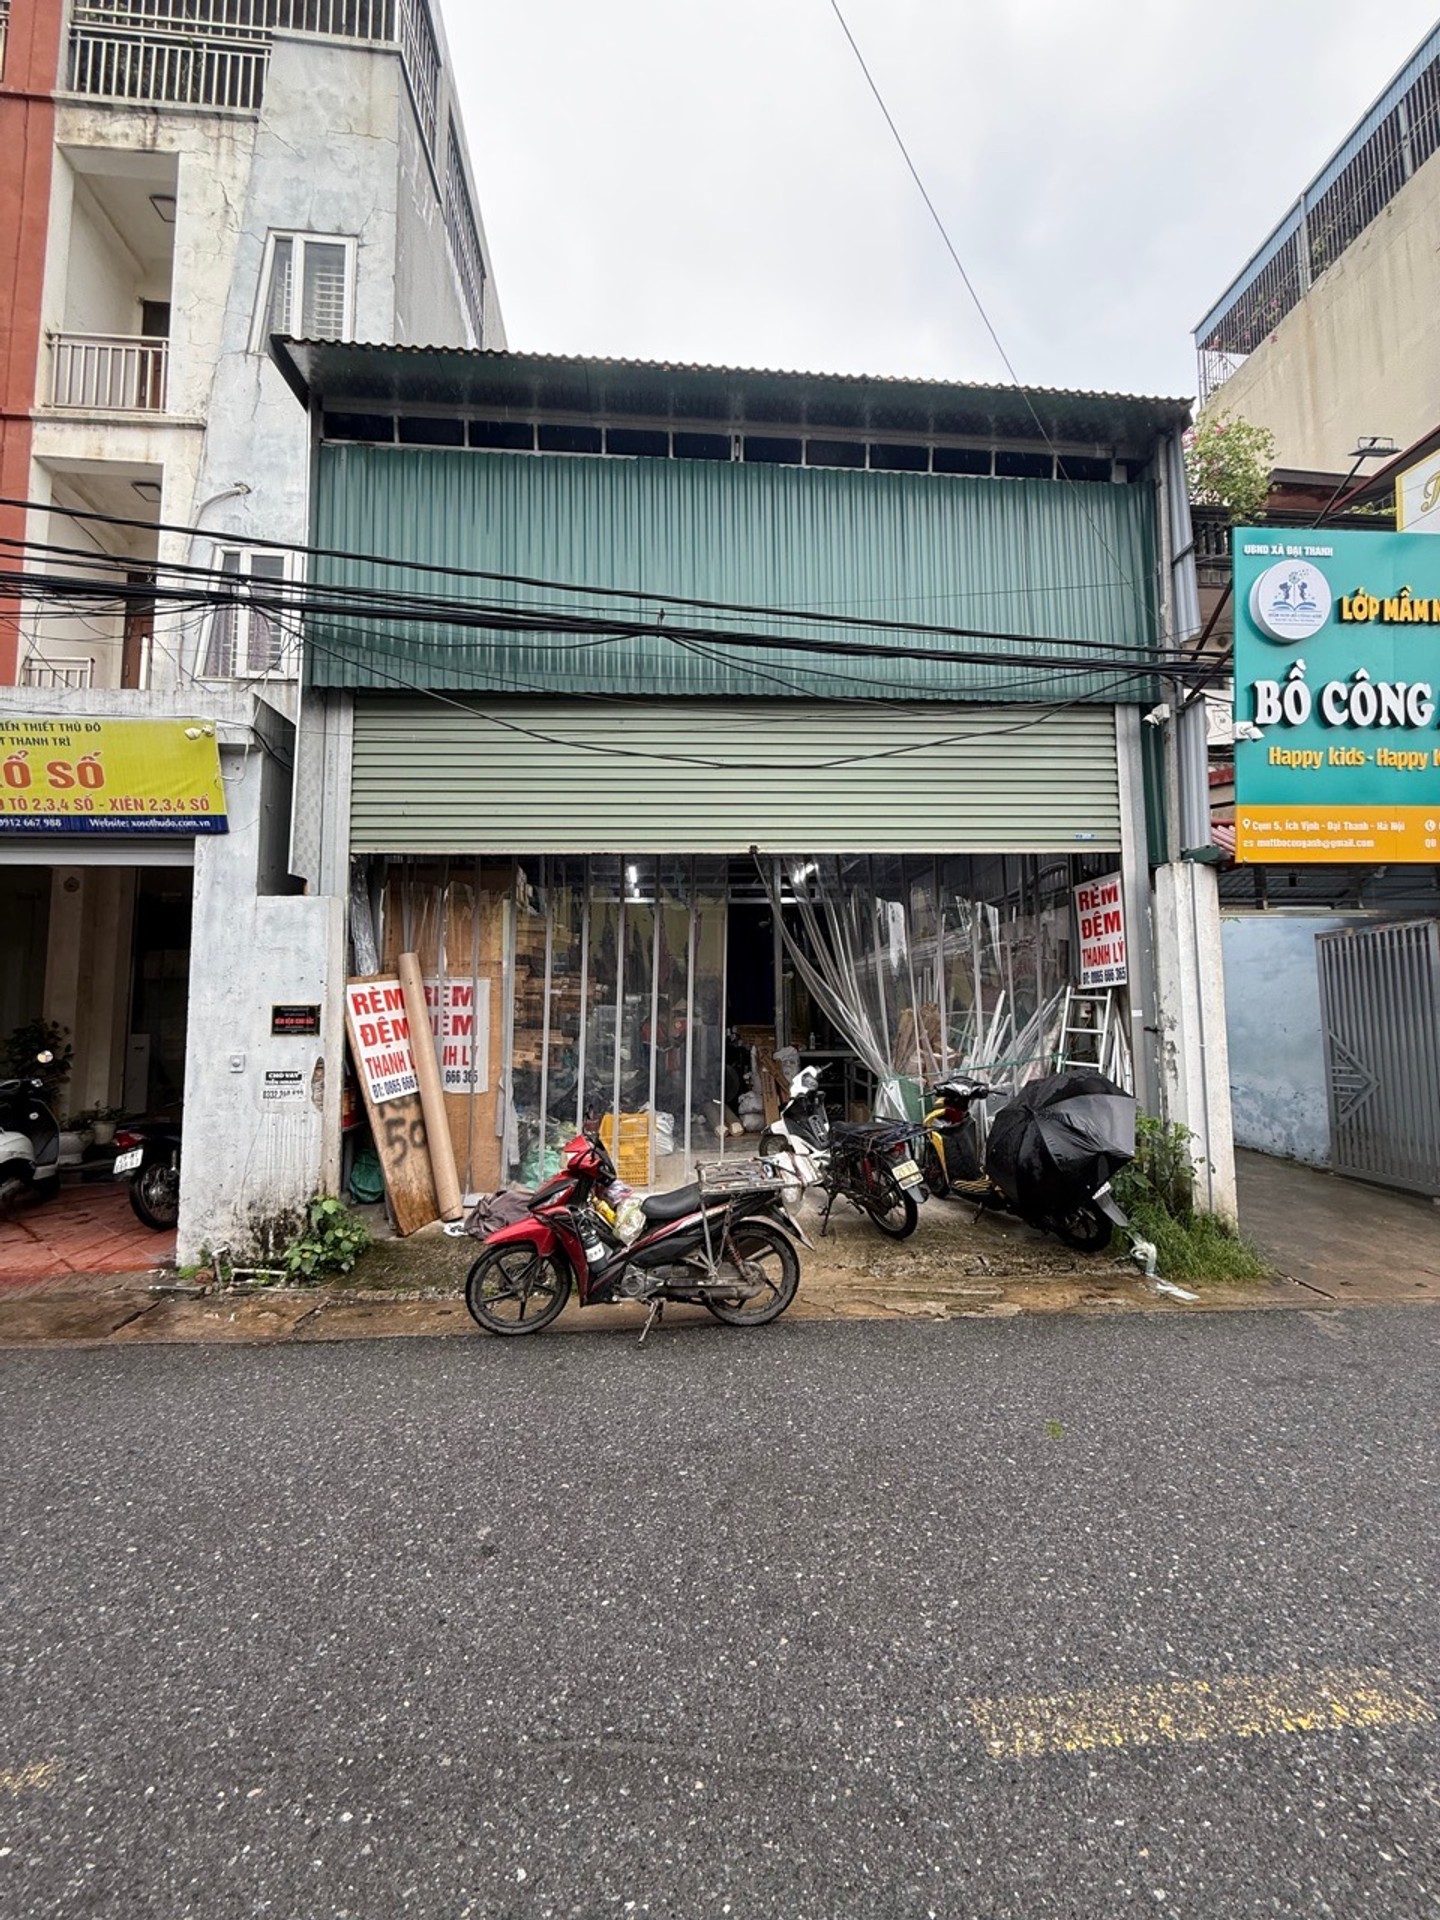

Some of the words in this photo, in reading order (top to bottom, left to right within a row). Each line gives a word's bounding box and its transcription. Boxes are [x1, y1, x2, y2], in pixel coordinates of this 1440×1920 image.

[1244, 544, 1269, 555] UBND
[1304, 545, 1334, 557] THANH
[1343, 586, 1380, 620] LỚP
[1384, 584, 1429, 622] MẦM
[1255, 658, 1312, 725] BỒ
[1322, 667, 1435, 726] CÔNG
[0, 720, 20, 732] IẾN
[23, 720, 55, 732] THIẾT
[59, 720, 82, 732] THỦ
[85, 721, 101, 732] ĐÔ
[9, 737, 49, 746] THANH
[52, 736, 71, 747] TRÌ
[0, 750, 31, 788] Ổ
[46, 751, 105, 789] SỐ
[1269, 746, 1323, 769] Happy
[1328, 746, 1365, 766] kids
[1377, 748, 1428, 771] Happy
[32, 798, 69, 812] 2,3,4
[73, 794, 94, 811] SỐ
[109, 796, 145, 811] XIÊN
[149, 798, 186, 812] 2,3,4
[190, 793, 210, 811] SỐ
[89, 818, 129, 828] Website:
[1343, 820, 1369, 831] Thanh
[1078, 882, 1118, 912] RÈM
[1081, 910, 1121, 942] ĐỆM
[1082, 943, 1111, 968] THANH
[1113, 937, 1124, 963] LÝ
[351, 985, 405, 1016] RÈM
[359, 1015, 410, 1049] ĐỆM
[365, 1050, 408, 1080] THANH
[446, 1070, 461, 1084] 666
[401, 1075, 415, 1090] 666
